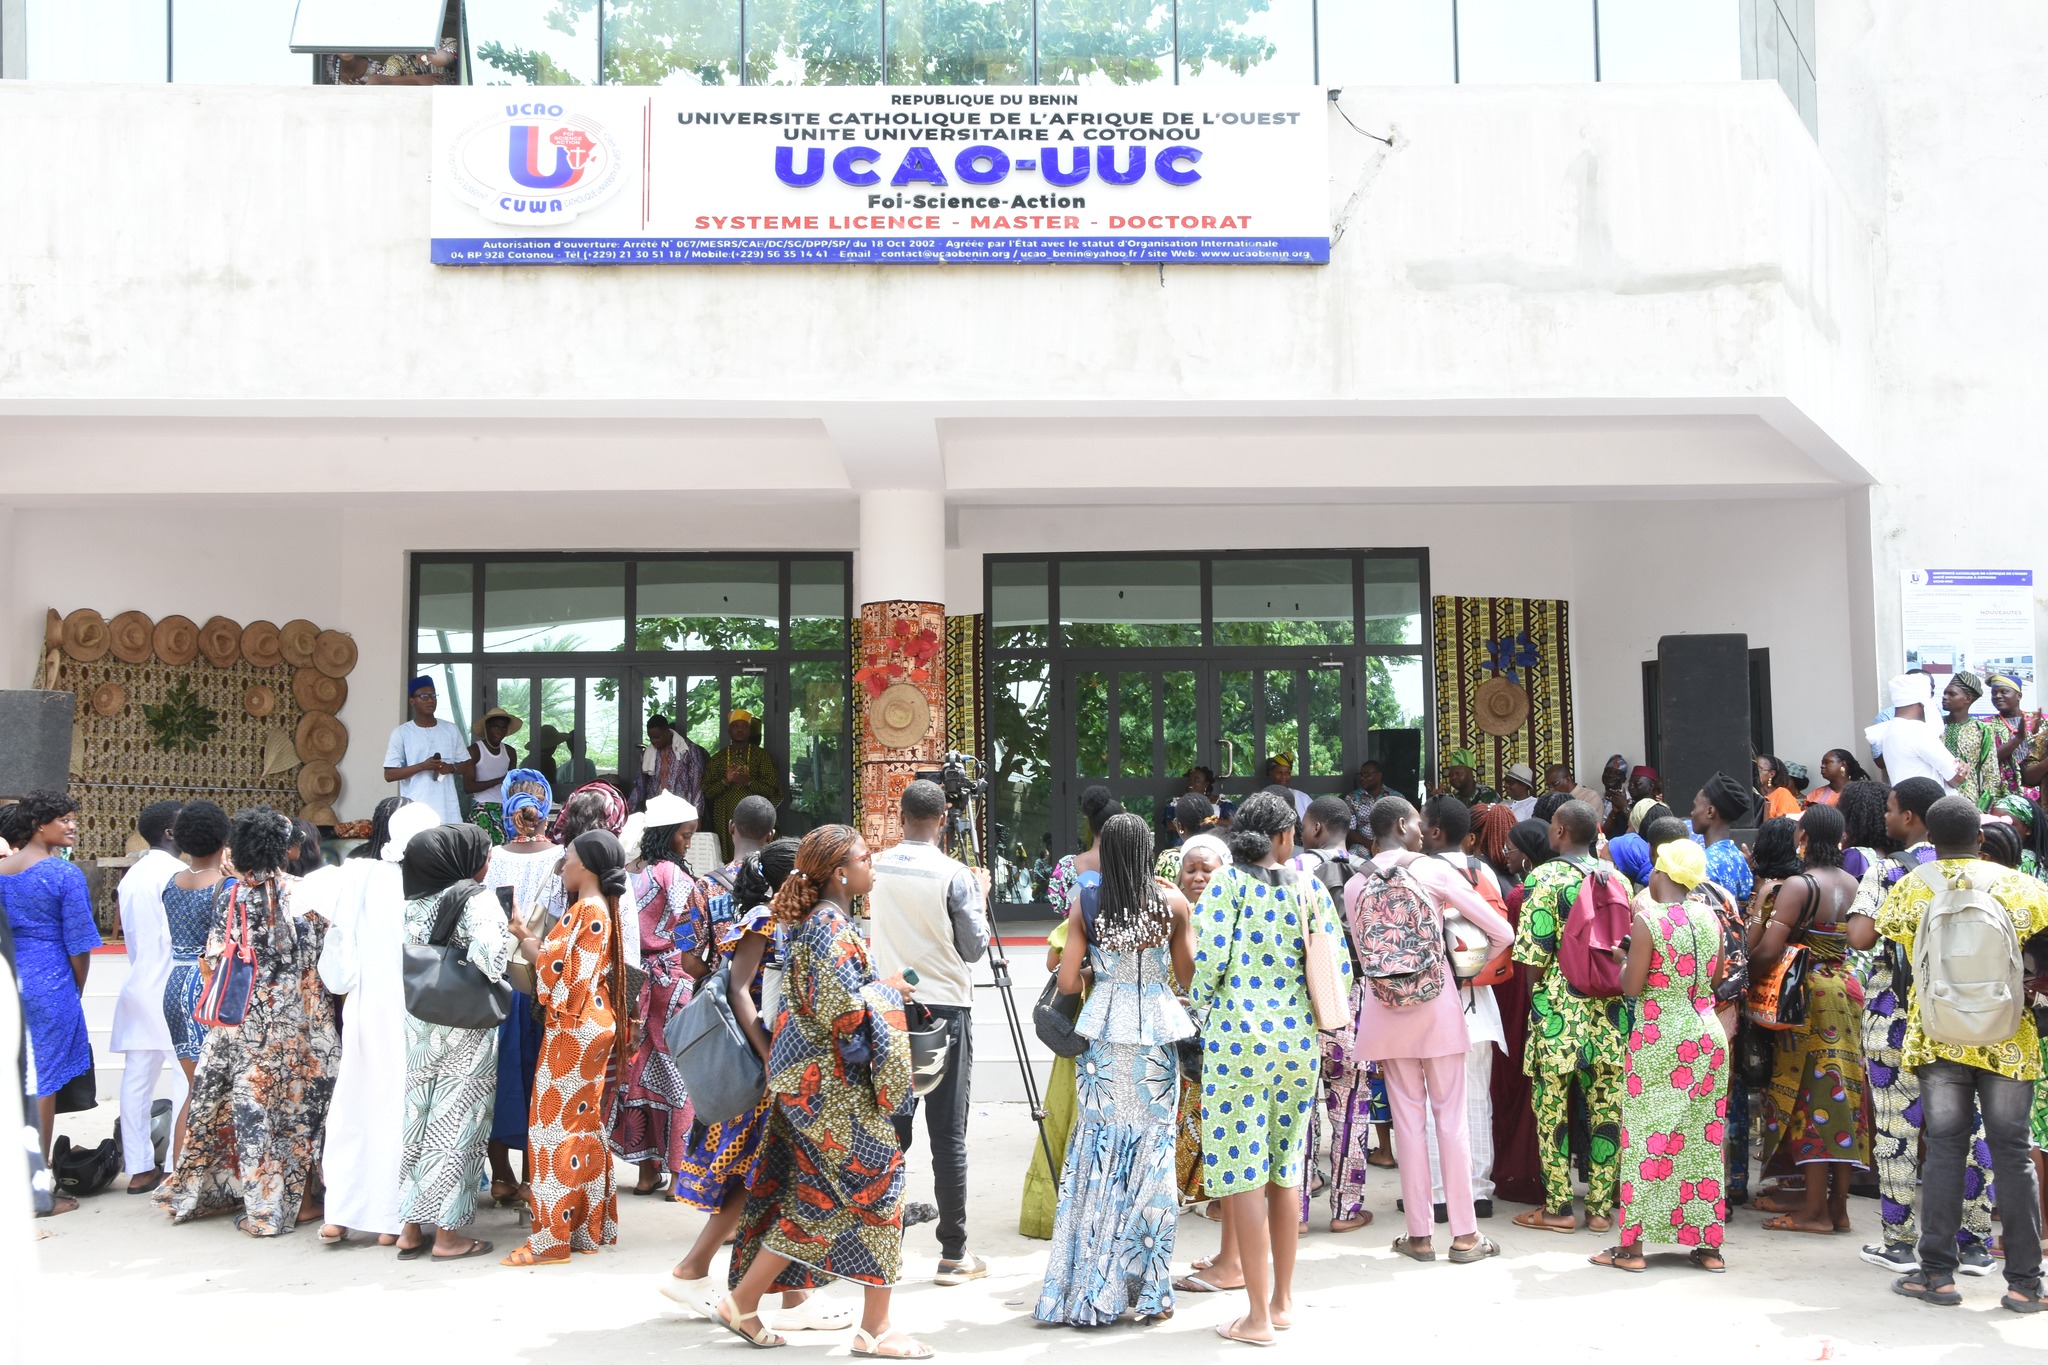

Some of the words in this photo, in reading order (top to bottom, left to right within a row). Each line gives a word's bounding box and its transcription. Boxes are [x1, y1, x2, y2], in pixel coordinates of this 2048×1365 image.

[891, 94, 995, 107] REPUBLIQUE
[1000, 94, 1023, 106] DU
[1028, 94, 1078, 106] BENIN
[506, 103, 564, 117] UCAO
[677, 112, 820, 126] UNIVERSITE
[828, 112, 981, 128] CATHOLIQUE
[989, 112, 1021, 125] DE
[1030, 111, 1154, 127] L'AFRIQUE
[1163, 111, 1194, 125] DE
[1202, 111, 1301, 126] L'OUEST
[783, 127, 856, 142] UNITE
[864, 127, 1049, 141] UNIVERSITAIRE
[1057, 127, 1075, 141] A
[1083, 127, 1201, 141] COTONOU
[774, 144, 1203, 189] UCAO-UUC
[499, 197, 563, 214] CUWA
[867, 193, 1086, 210] Foi-Science-Action
[694, 215, 819, 231] SYSTEME
[829, 215, 941, 231] LICENCE
[970, 215, 1080, 230] MASTER
[1109, 215, 1252, 230] DOCTORAT
[482, 240, 551, 249] Autorisation
[852, 239, 867, 249] du
[871, 239, 884, 249] 18
[886, 239, 906, 249] Oct
[909, 239, 935, 249] 2002
[945, 239, 985, 250] Agréée
[987, 240, 1006, 250] par
[1040, 240, 1065, 248] avec
[1068, 239, 1079, 249] le
[1081, 239, 1114, 249] statut
[1117, 239, 1198, 250] d'Organisation
[1201, 239, 1278, 248] Internationale
[450, 251, 464, 259] 04
[467, 251, 483, 259] BP
[484, 251, 505, 259] 928
[507, 251, 554, 259] Cotonou
[583, 250, 617, 261] (+229)
[619, 250, 632, 259] 21
[636, 250, 649, 259] 30
[652, 250, 664, 259] 51
[669, 250, 681, 259] 18
[684, 250, 690, 259] /
[767, 250, 781, 259] 56
[783, 250, 797, 259] 35
[800, 250, 813, 259] 14
[815, 250, 829, 259] 41
[839, 250, 871, 259] Email
[1012, 250, 1018, 259] /
[1140, 249, 1146, 258] /
[1147, 249, 1168, 258] site
[1170, 249, 1198, 258] Web:
[1200, 250, 1311, 260] www.ucaobenin.org
